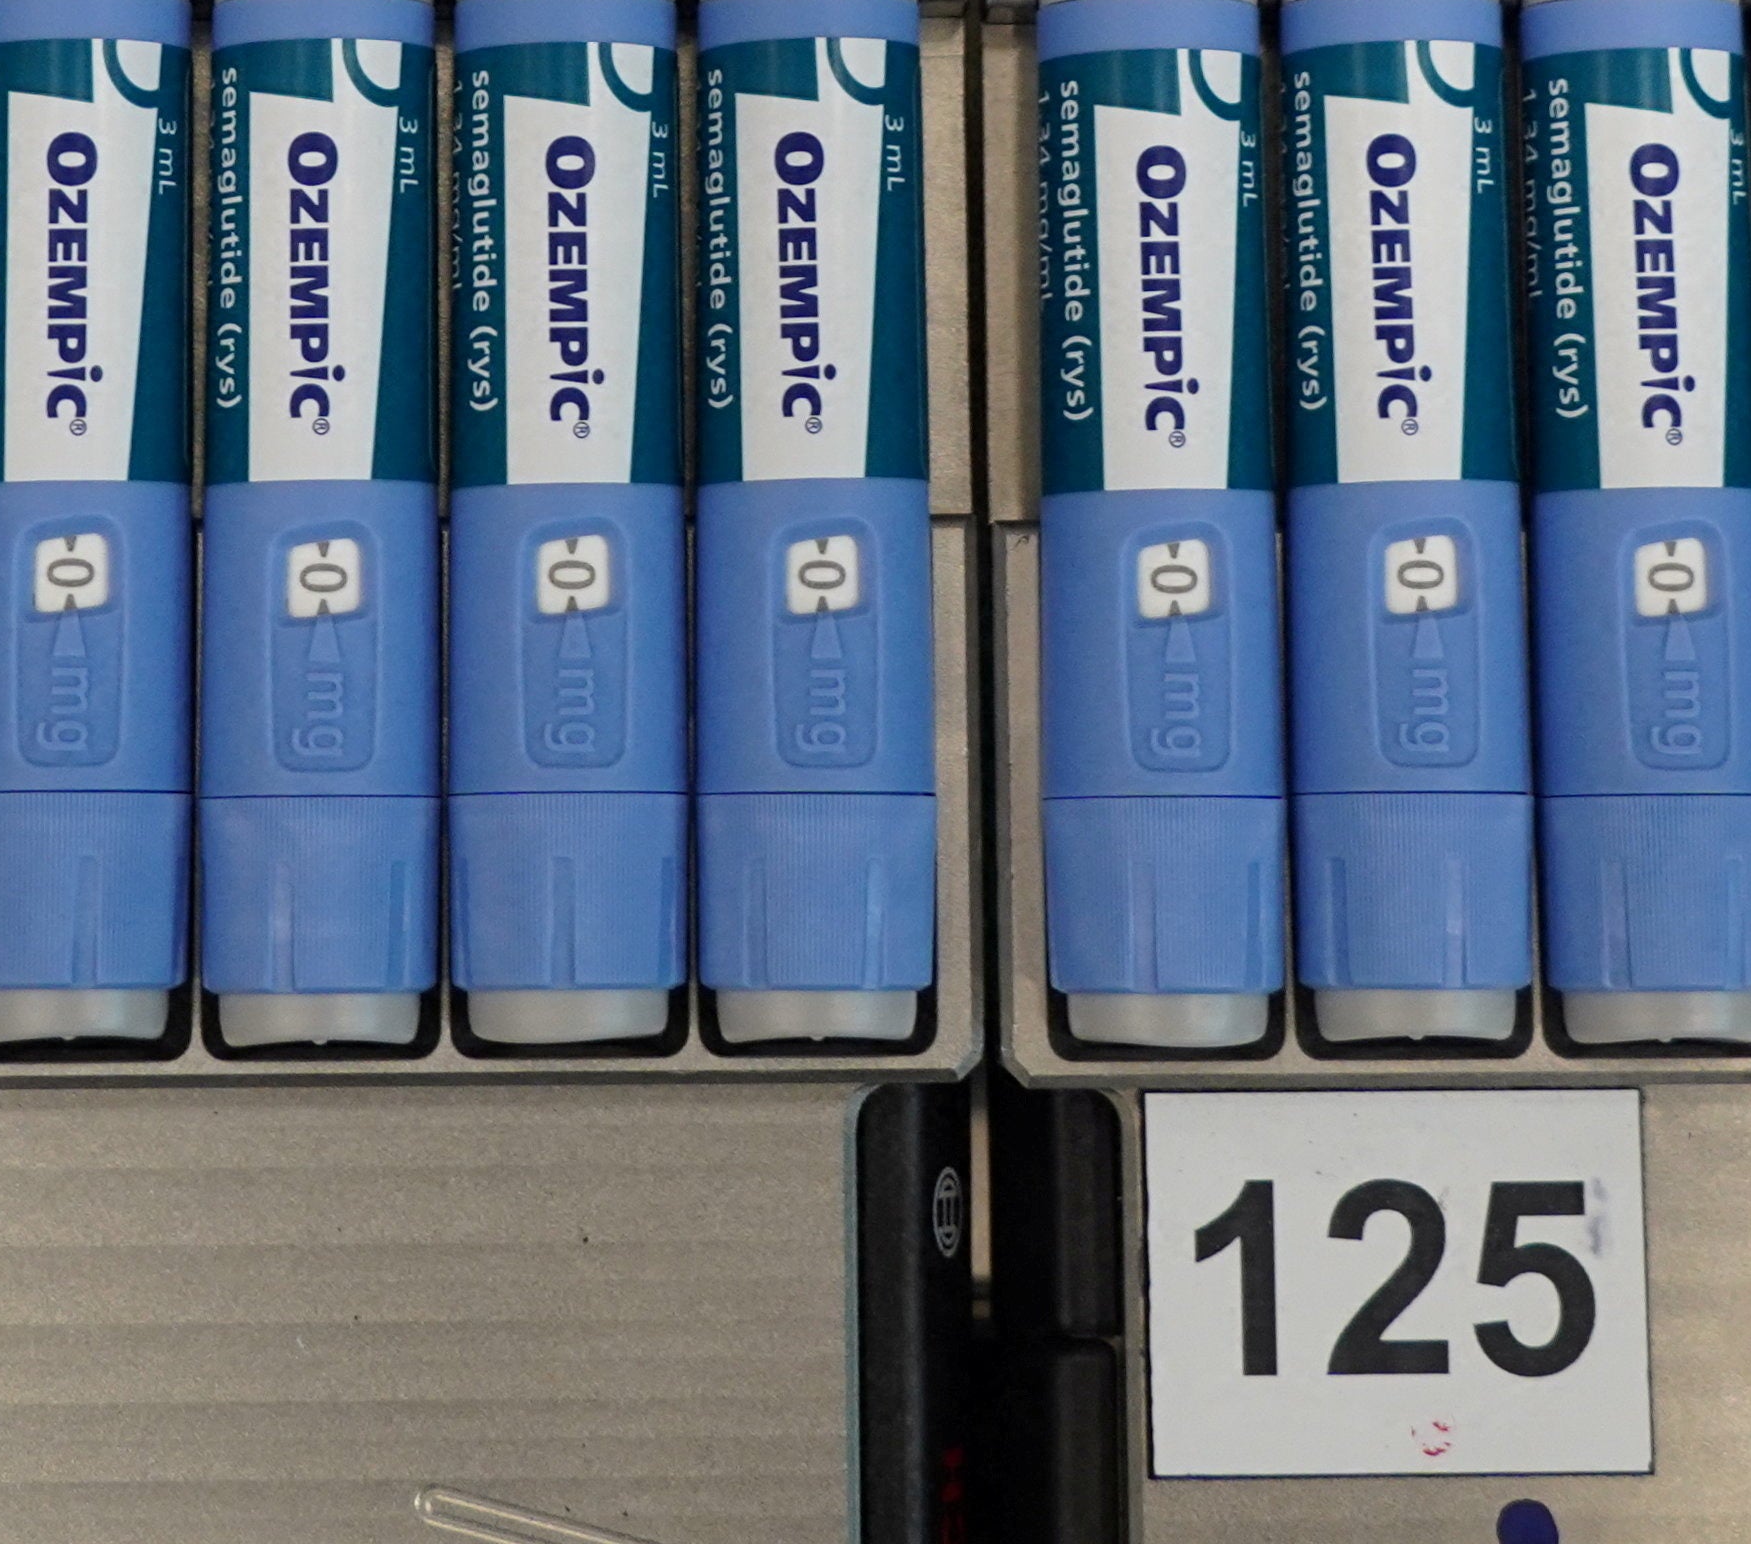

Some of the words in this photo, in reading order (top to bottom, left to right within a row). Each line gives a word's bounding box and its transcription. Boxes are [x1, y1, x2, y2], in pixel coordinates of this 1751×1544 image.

[159, 119, 176, 134] 3
[400, 118, 417, 133] 3
[652, 122, 667, 138] 3
[885, 115, 903, 131] 3
[1241, 132, 1255, 147] 3
[1474, 118, 1491, 133] 3
[160, 149, 176, 194] mL
[218, 68, 242, 308] semaglutide
[401, 148, 418, 192] mL
[468, 71, 497, 311] semaglutide
[653, 152, 668, 197] mL
[706, 70, 731, 308] semaglutide
[887, 146, 904, 190] mL
[1058, 81, 1090, 320] semaglutide
[1243, 162, 1257, 205] mL
[1294, 72, 1322, 310] semaglutide
[1476, 148, 1493, 192] mL
[1547, 79, 1583, 318] semaglutide
[1731, 158, 1746, 206] mL
[217, 324, 241, 407] (rys)
[468, 326, 498, 410] (rys)
[708, 324, 732, 408] (rys)
[1062, 336, 1093, 420] (rys)
[1298, 326, 1326, 409] (rys)
[1554, 334, 1588, 418] (rys)
[47, 558, 94, 587] 0
[300, 563, 347, 593] 0
[548, 560, 595, 590] 0
[798, 560, 846, 590] 0
[1150, 565, 1198, 594] 0
[1397, 560, 1444, 589] 0
[1648, 563, 1695, 592] 0
[37, 669, 90, 751] mg
[292, 674, 344, 758] mg
[544, 668, 595, 752] mg
[796, 666, 845, 748] mg
[1151, 672, 1201, 756] mg
[1399, 668, 1449, 751] mg
[1652, 670, 1700, 755] mg
[1193, 1178, 1597, 1377] 125
